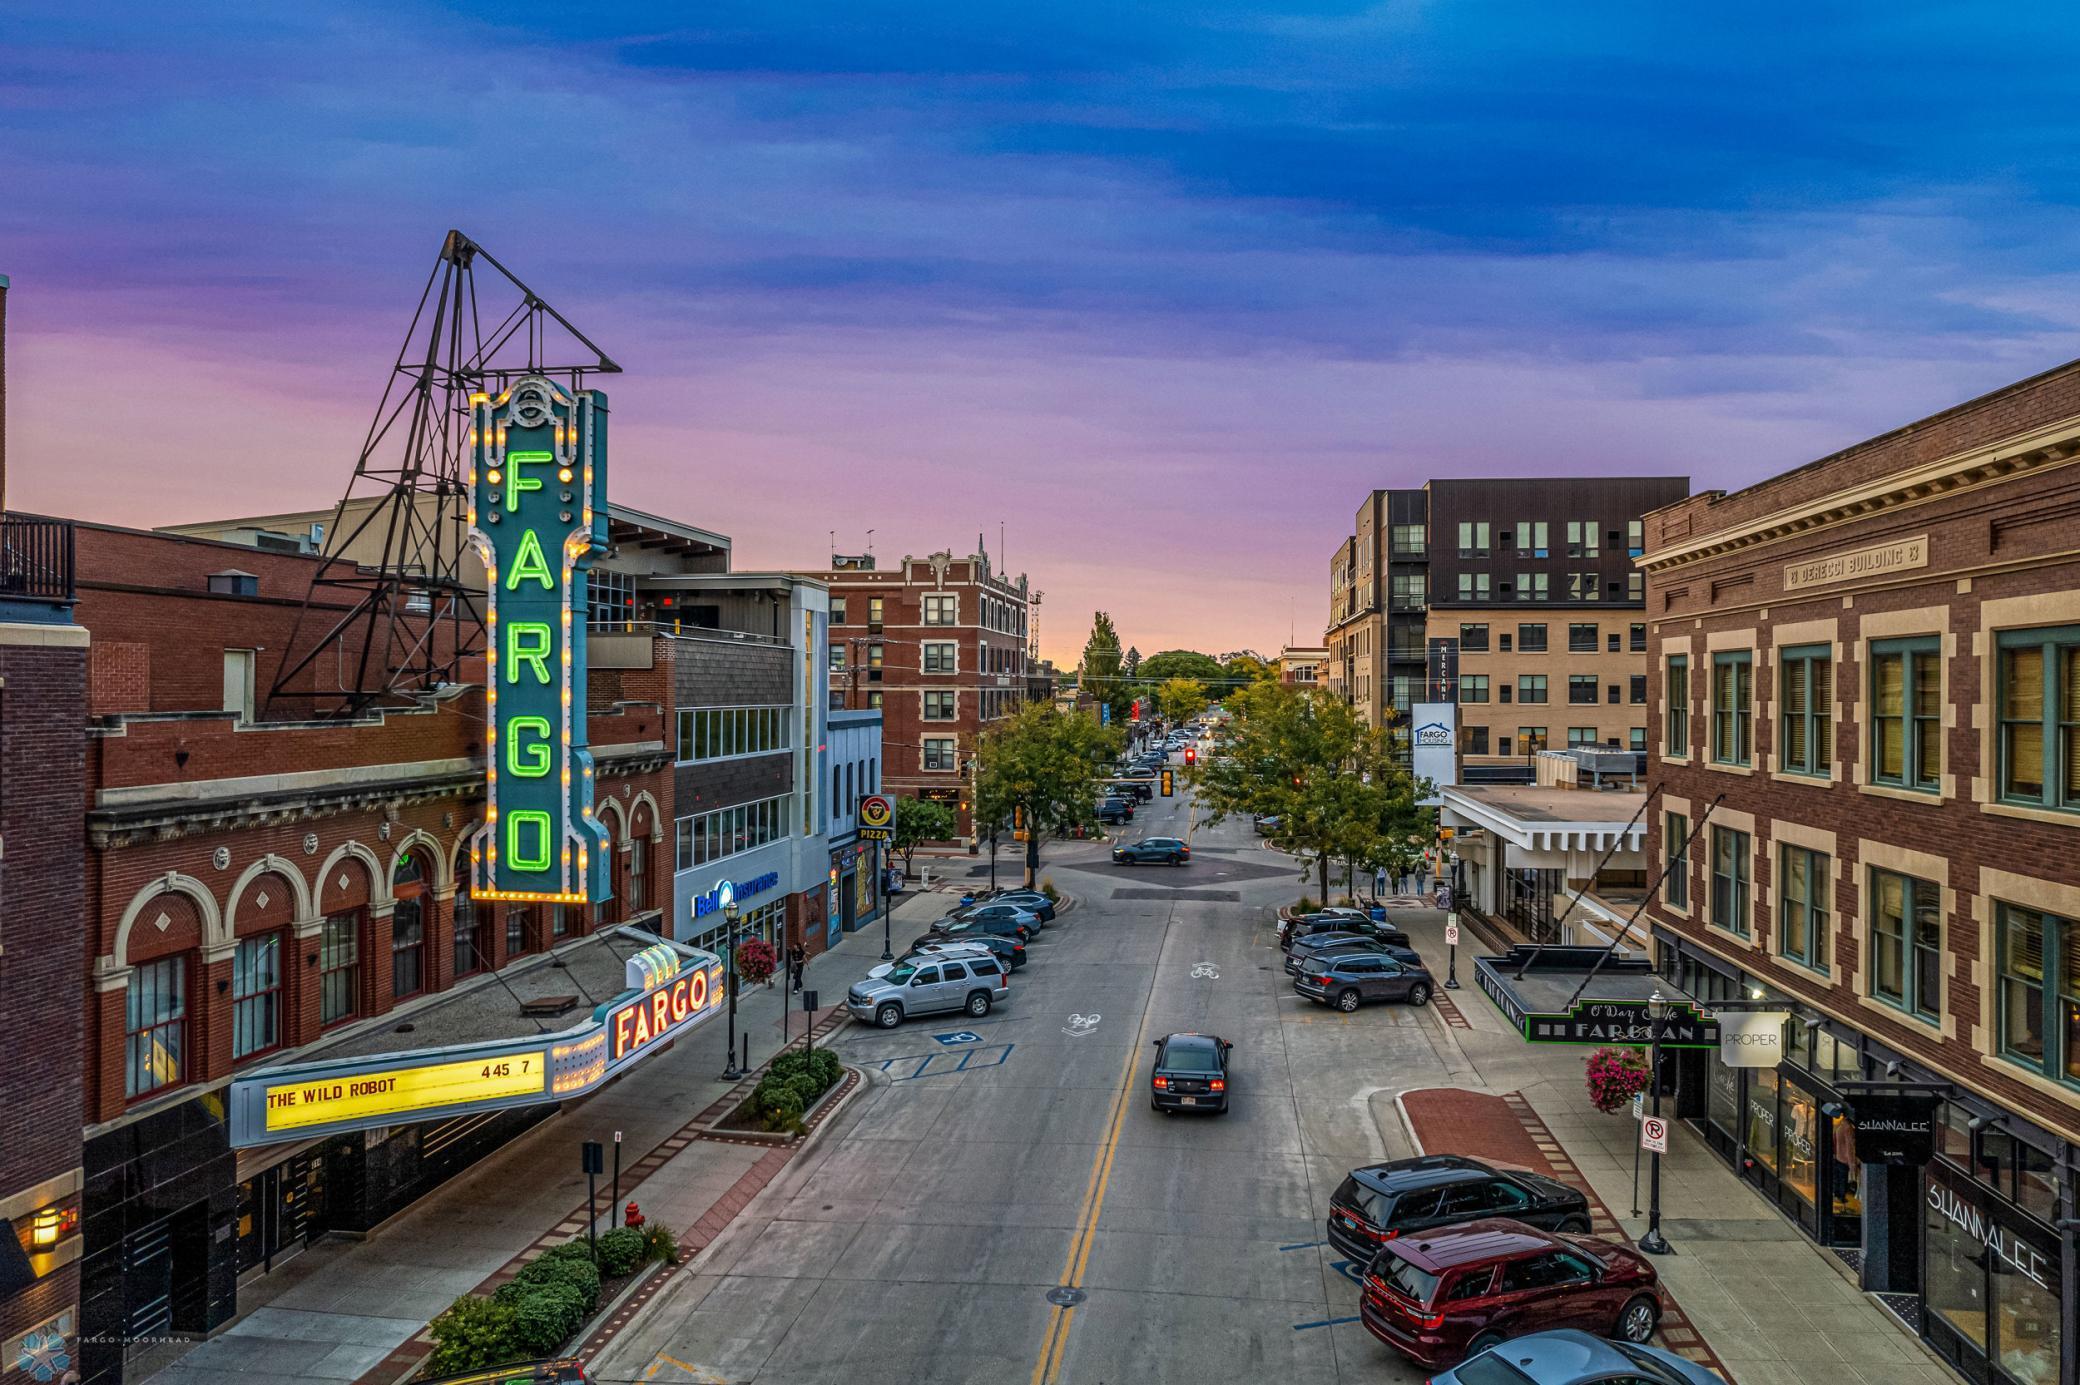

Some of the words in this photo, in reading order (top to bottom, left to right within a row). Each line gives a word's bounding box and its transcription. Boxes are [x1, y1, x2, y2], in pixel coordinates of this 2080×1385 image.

[1849, 548, 1903, 573] BUILDING
[505, 450, 554, 873] FARGO
[1440, 645, 1448, 703] MERCANT
[1419, 730, 1448, 738] FARGO
[860, 829, 888, 840] PIZZA
[693, 888, 720, 918] Bell
[733, 871, 779, 902] Insurance
[614, 968, 708, 1060] FARGO
[1641, 1005, 1679, 1021] Che
[1725, 1034, 1777, 1045] PROPER
[522, 1060, 530, 1074] 7
[267, 1090, 296, 1109] THE
[303, 1085, 342, 1103] WILD
[349, 1077, 397, 1098] ROBOT
[1750, 1099, 1774, 1128] PROPER
[1784, 1125, 1811, 1157] PROPER
